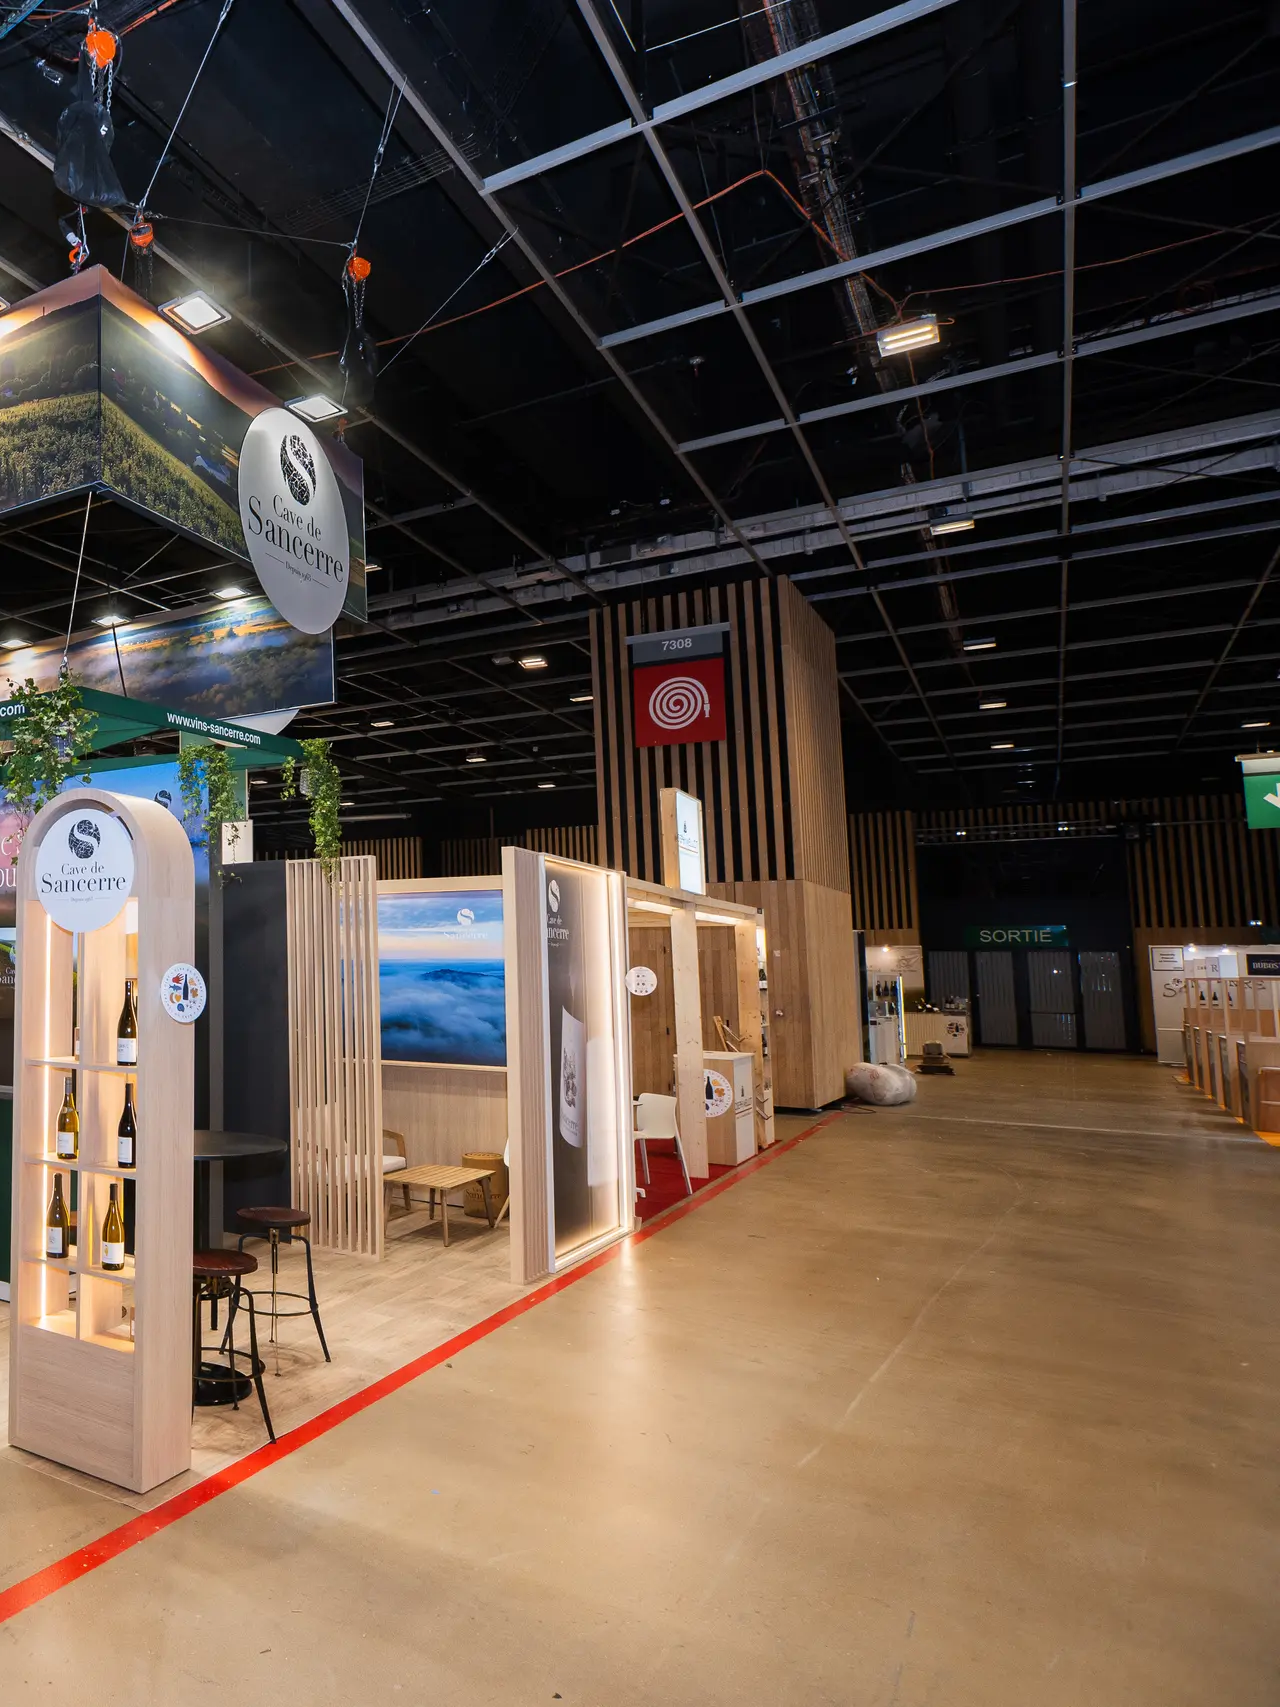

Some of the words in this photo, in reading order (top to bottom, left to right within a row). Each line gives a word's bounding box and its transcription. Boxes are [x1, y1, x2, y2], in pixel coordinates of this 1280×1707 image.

[272, 494, 303, 525] Cave
[306, 516, 322, 541] de
[247, 495, 344, 583] Sancerre
[661, 638, 692, 650] 7308
[166, 712, 261, 745] www.vins-sancerre.com
[61, 863, 87, 875] Cave
[91, 861, 105, 873] de
[41, 873, 126, 893] Sancerre
[547, 928, 570, 940] ncerre
[979, 929, 1052, 943] SORTIE
